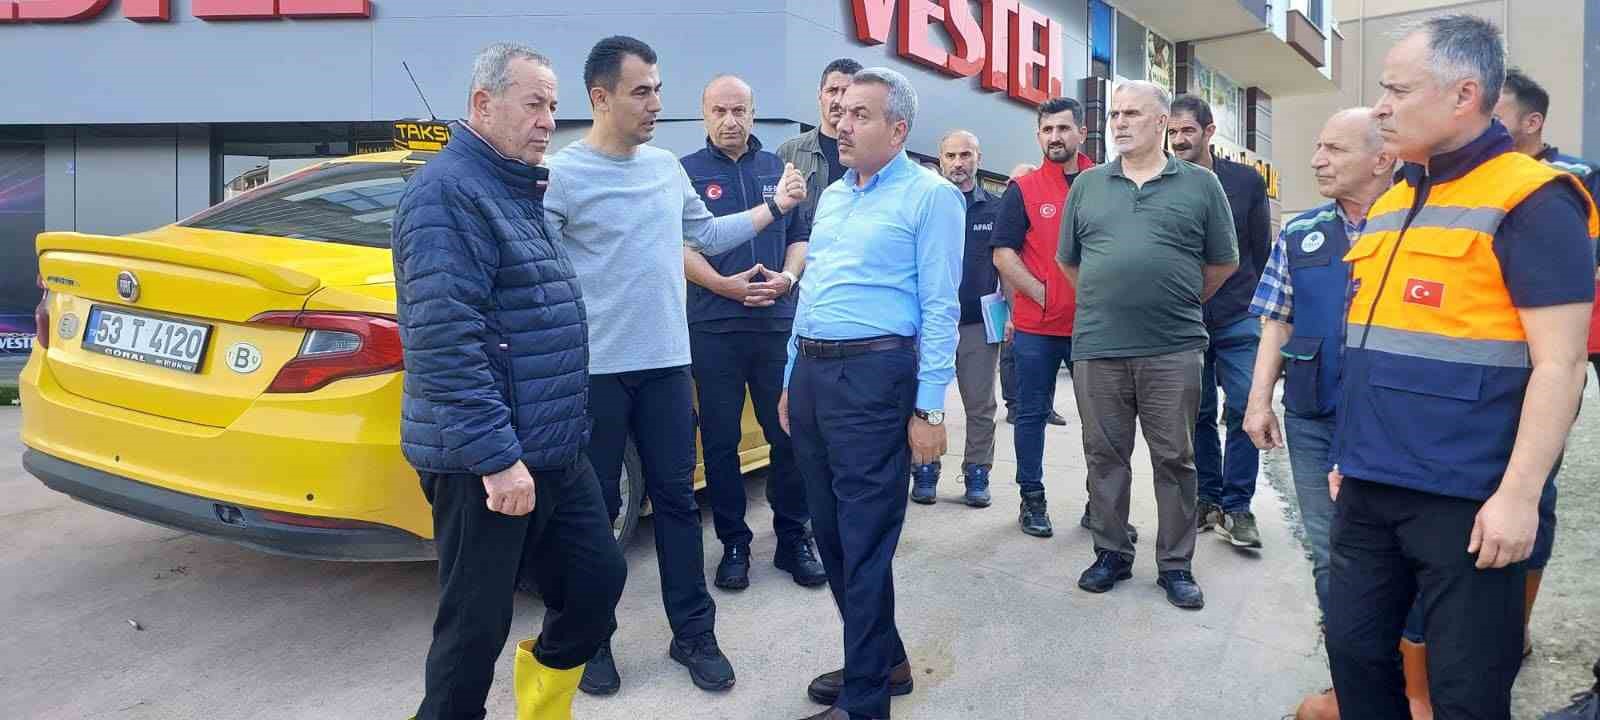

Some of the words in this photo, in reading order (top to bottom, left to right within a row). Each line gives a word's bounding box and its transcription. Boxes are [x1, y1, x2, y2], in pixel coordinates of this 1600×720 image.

[0, 337, 33, 349] VEST
[97, 314, 123, 345] 53
[131, 319, 145, 349] T
[149, 322, 202, 360] 4120
